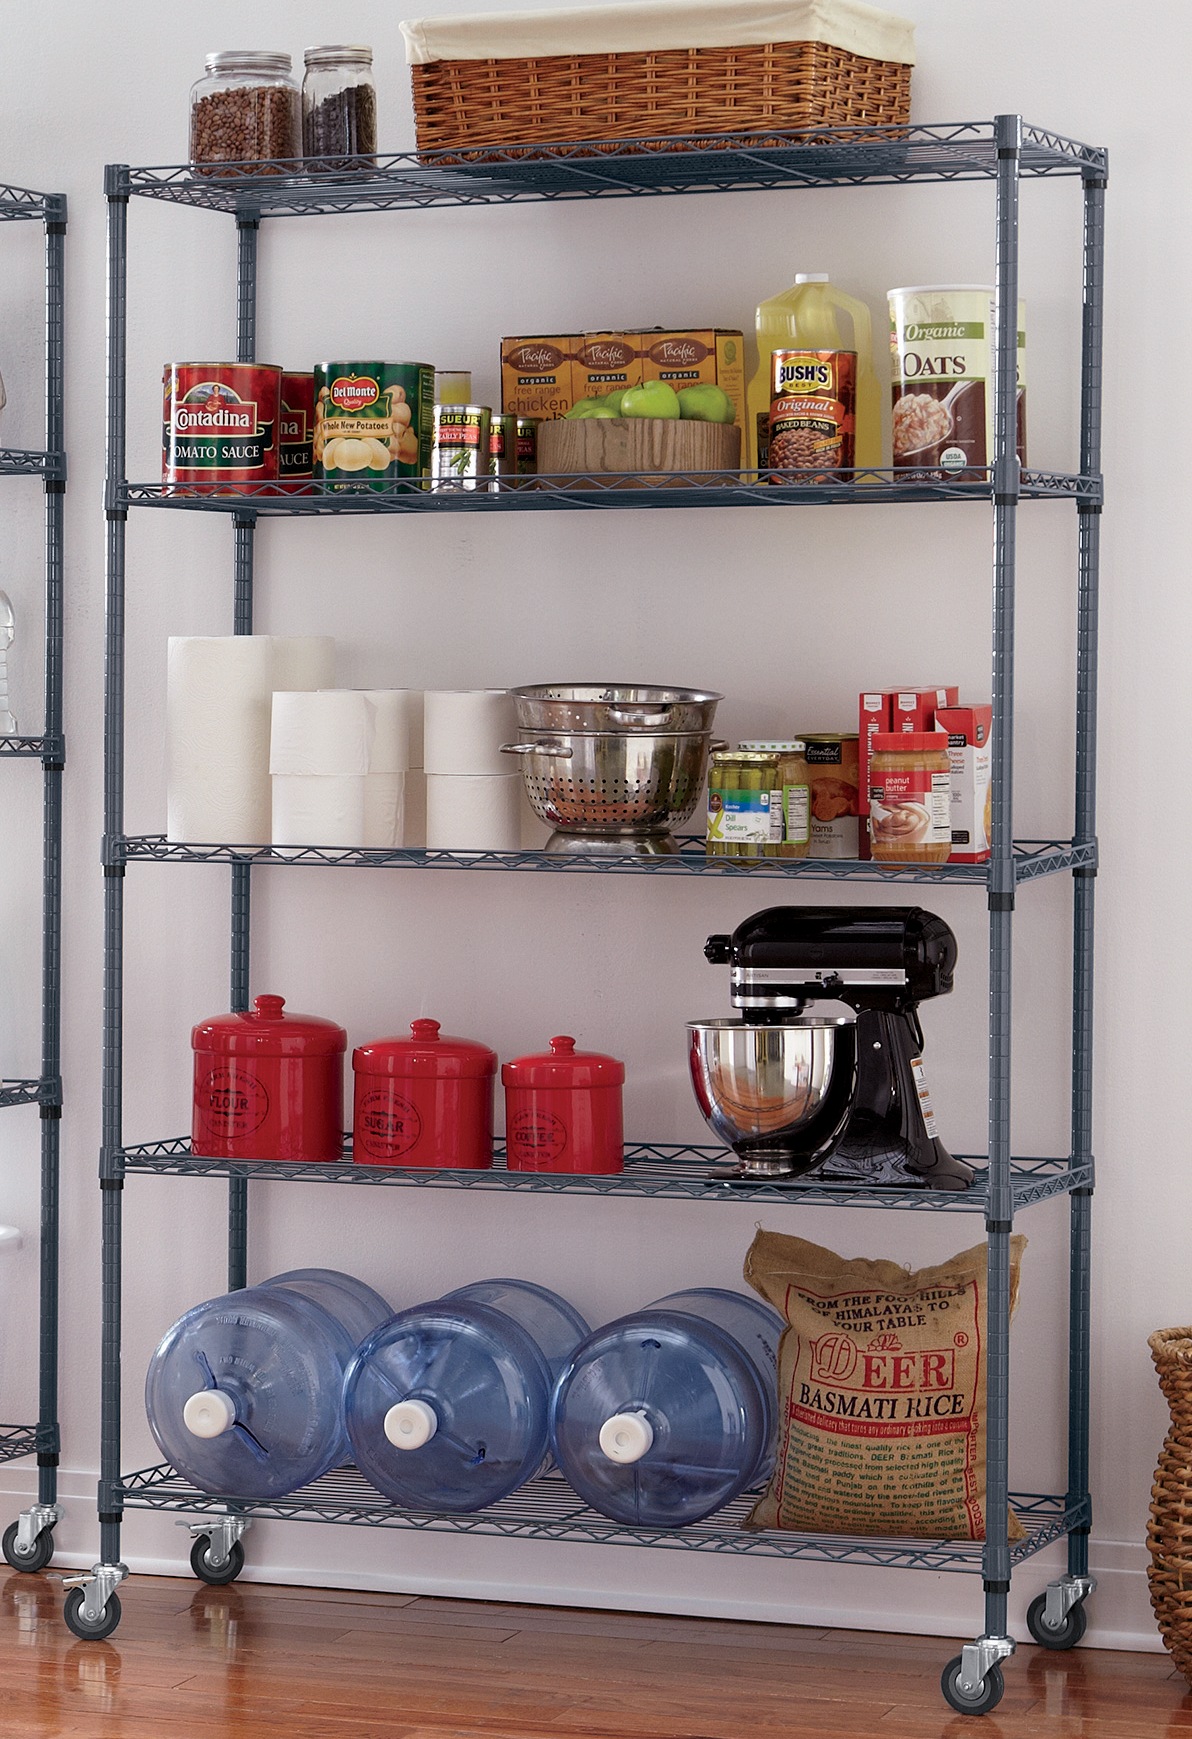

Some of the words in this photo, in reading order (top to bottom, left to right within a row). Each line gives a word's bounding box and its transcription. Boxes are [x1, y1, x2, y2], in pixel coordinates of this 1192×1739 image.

[906, 322, 965, 340] Organic
[518, 347, 552, 364] Pacific
[588, 345, 623, 361] Pacific
[659, 342, 695, 358] Pacific
[904, 353, 966, 377] OATS
[590, 374, 625, 382] organic
[662, 371, 698, 379] organic
[780, 365, 828, 384] BUSH'S
[520, 377, 554, 385] organic
[333, 387, 346, 397] Del
[347, 386, 376, 397] Monte
[514, 386, 532, 395] free
[535, 386, 561, 396] range
[584, 383, 603, 392] free
[508, 396, 569, 412] chicken
[777, 399, 830, 412] Original
[175, 408, 250, 430] Contadina
[323, 421, 339, 430] Whole
[340, 421, 355, 430] New
[356, 421, 389, 430] Potatoes
[776, 421, 799, 431] BAKED
[800, 421, 829, 430] BEANS
[173, 445, 217, 459] OMATO
[222, 445, 260, 459] SAUCE
[280, 453, 309, 466] AUCE
[807, 746, 839, 756] Essential
[885, 777, 910, 785] peanut
[725, 823, 748, 832] Spears
[811, 824, 833, 832] Yams
[210, 1096, 249, 1109] FLOUR
[365, 1116, 404, 1133] SUGAR
[843, 1295, 871, 1307] THE
[835, 1303, 923, 1321] HIMALAYAS
[927, 1300, 950, 1311] TO
[832, 1319, 874, 1333] YOUR
[876, 1314, 927, 1332] TABLE
[814, 1332, 949, 1389] DEER
[800, 1383, 898, 1419] BASMATI
[904, 1394, 965, 1418] RICE
[841, 1441, 862, 1449] finest
[865, 1444, 893, 1453] quality
[871, 1453, 895, 1461] DEER
[921, 1460, 939, 1470] high
[832, 1470, 855, 1480] paddy
[967, 1467, 979, 1493] BEST
[836, 1479, 863, 1491] Punjab
[865, 1493, 875, 1501] by
[877, 1492, 890, 1500] the
